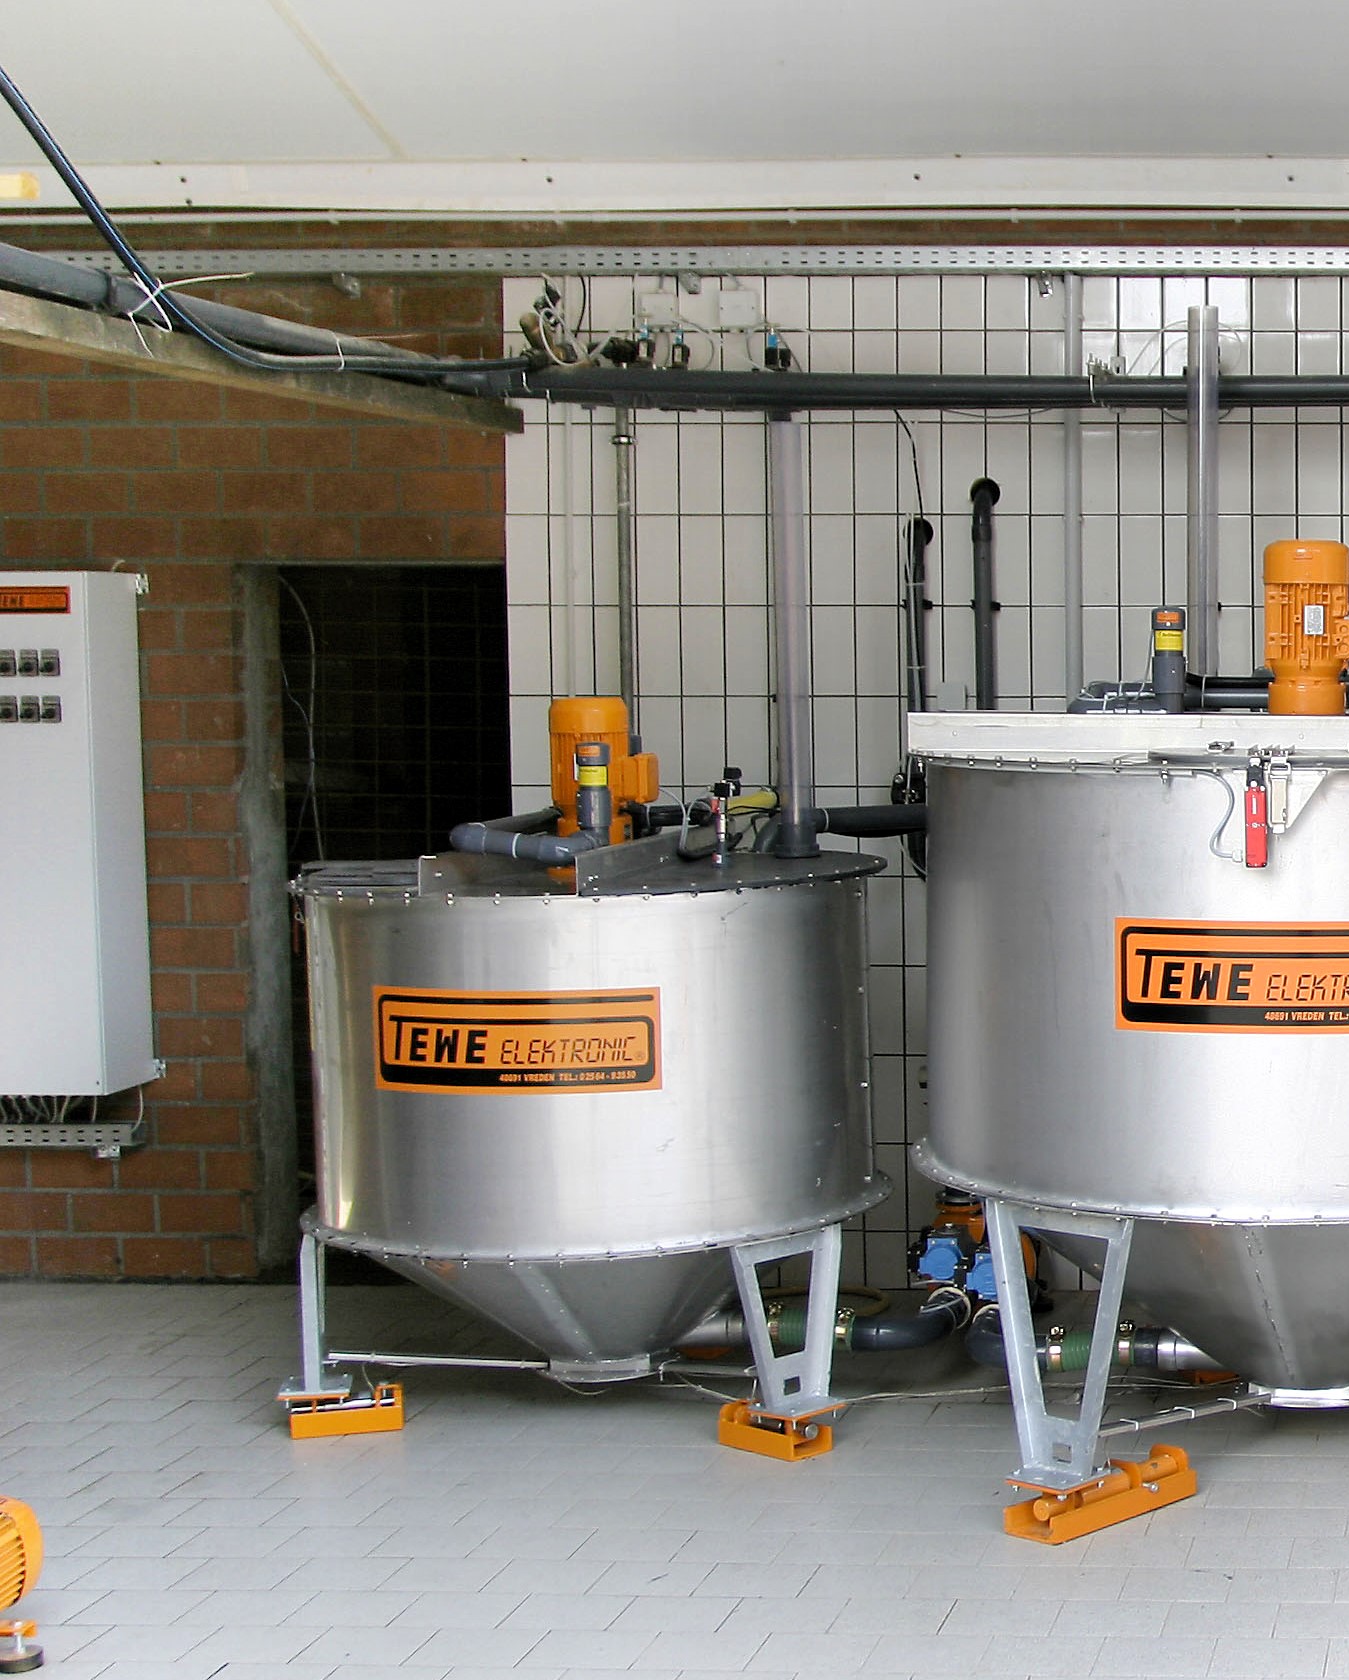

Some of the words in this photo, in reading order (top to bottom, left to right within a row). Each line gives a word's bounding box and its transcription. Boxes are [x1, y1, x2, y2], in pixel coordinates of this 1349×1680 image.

[1135, 948, 1254, 1001] TEWE
[389, 1014, 488, 1064] TEWE
[500, 1036, 637, 1065] ELEKTRONIC
[1291, 1011, 1325, 1021] VREDEN
